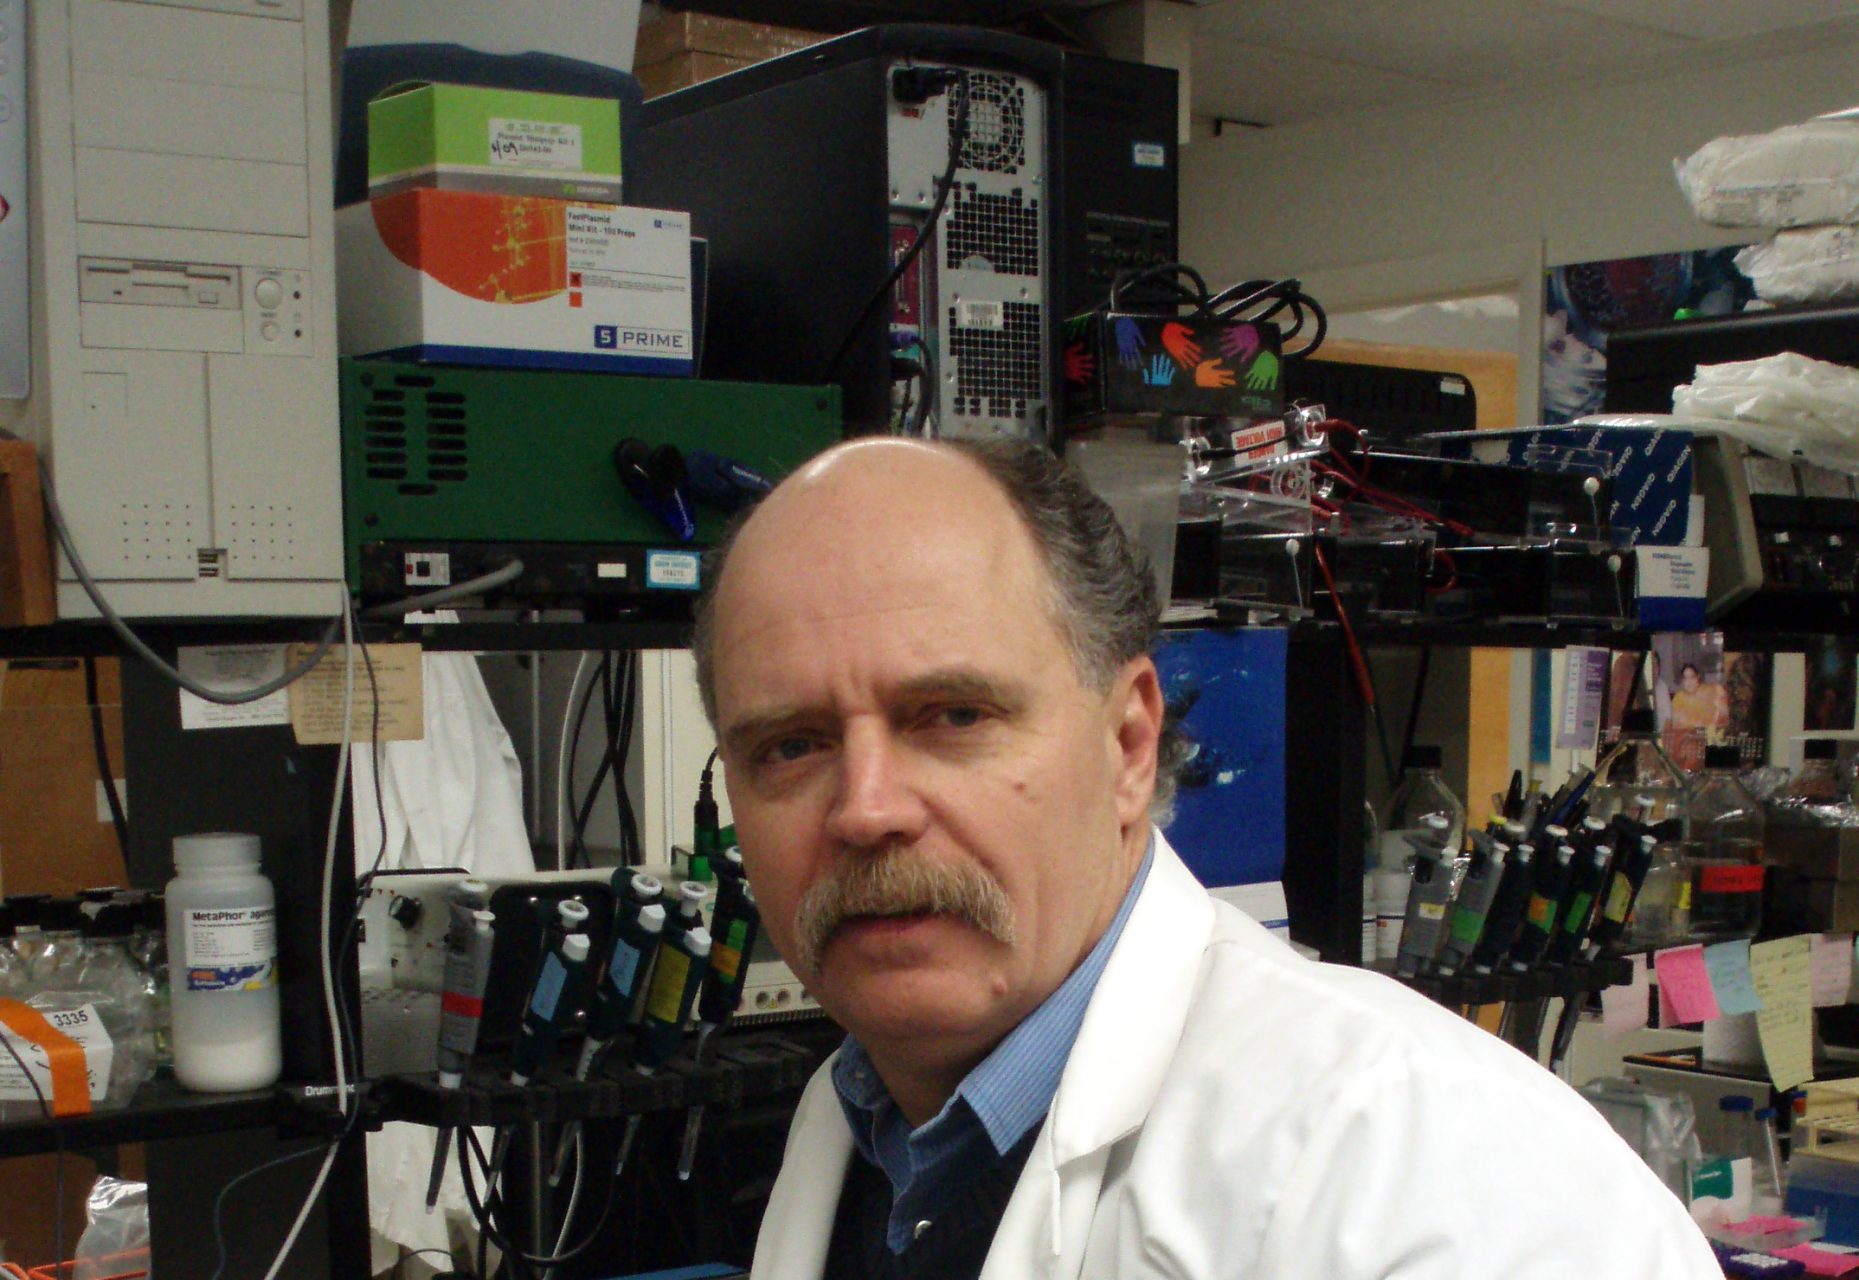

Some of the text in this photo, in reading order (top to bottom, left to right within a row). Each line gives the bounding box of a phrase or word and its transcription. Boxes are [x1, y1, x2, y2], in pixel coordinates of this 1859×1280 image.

[568, 212, 611, 223] FastPlasmid
[569, 224, 584, 233] Mini
[622, 331, 684, 349] PRIME
[1666, 444, 1692, 483] QIAGEN
[1630, 472, 1657, 511] QIAGEN
[1651, 499, 1677, 536] QIAGEN
[53, 1009, 89, 1027] 3335
